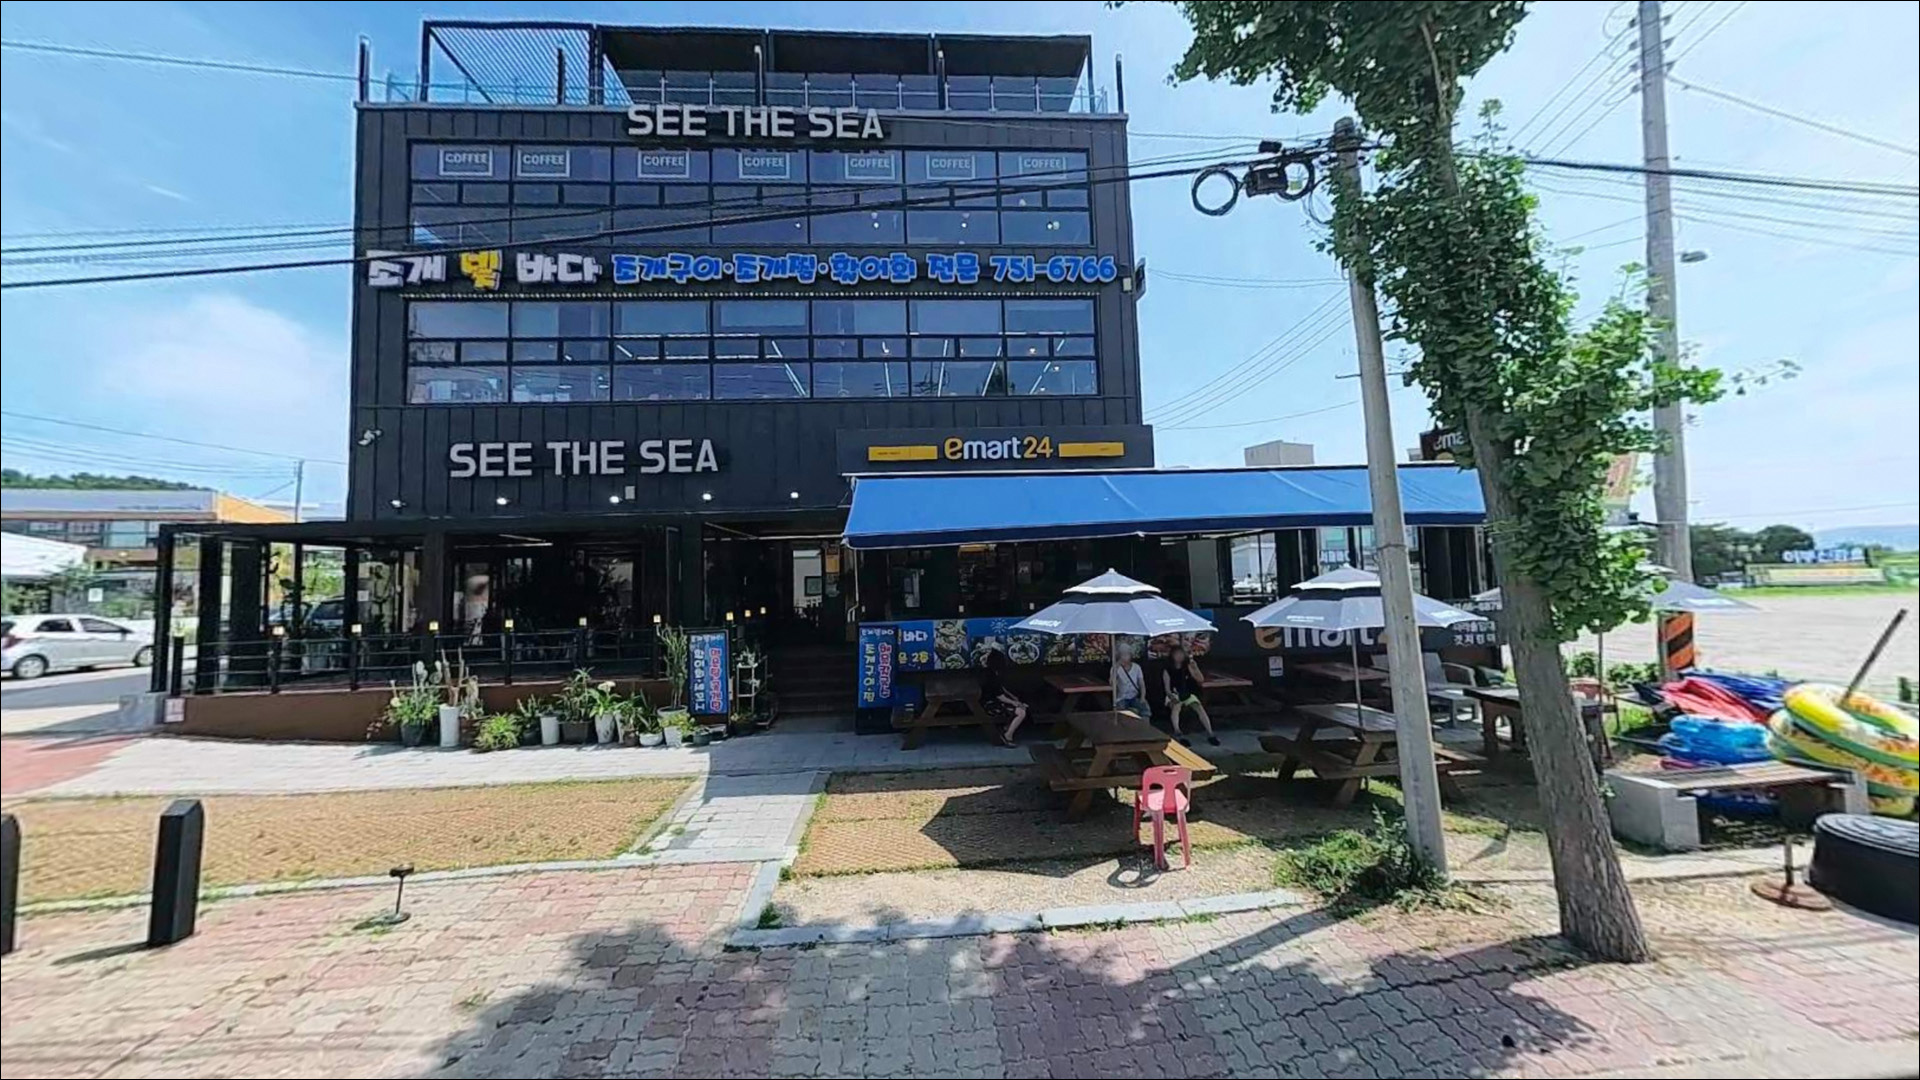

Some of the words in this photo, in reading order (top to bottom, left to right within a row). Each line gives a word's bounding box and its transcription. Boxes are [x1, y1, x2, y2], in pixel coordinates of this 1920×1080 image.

[627, 104, 707, 136] SEE
[720, 105, 796, 137] THE
[808, 106, 884, 139] SEA
[445, 152, 489, 164] COFFEE
[521, 153, 565, 165] COFFEE
[643, 155, 685, 167] COFFEE
[744, 156, 785, 168] COFFEE
[850, 157, 890, 169] COFFEE
[931, 157, 971, 169] COFFEE
[1023, 157, 1062, 169] COFFEE
[366, 250, 447, 287] 조개
[517, 252, 603, 284] 바다
[926, 251, 980, 283] 전문
[990, 254, 1117, 283] 751-6766
[943, 435, 1054, 461] emart24
[449, 442, 533, 478] SEE
[546, 440, 625, 476] THE
[639, 438, 719, 474] SEA
[903, 630, 929, 642] 바다
